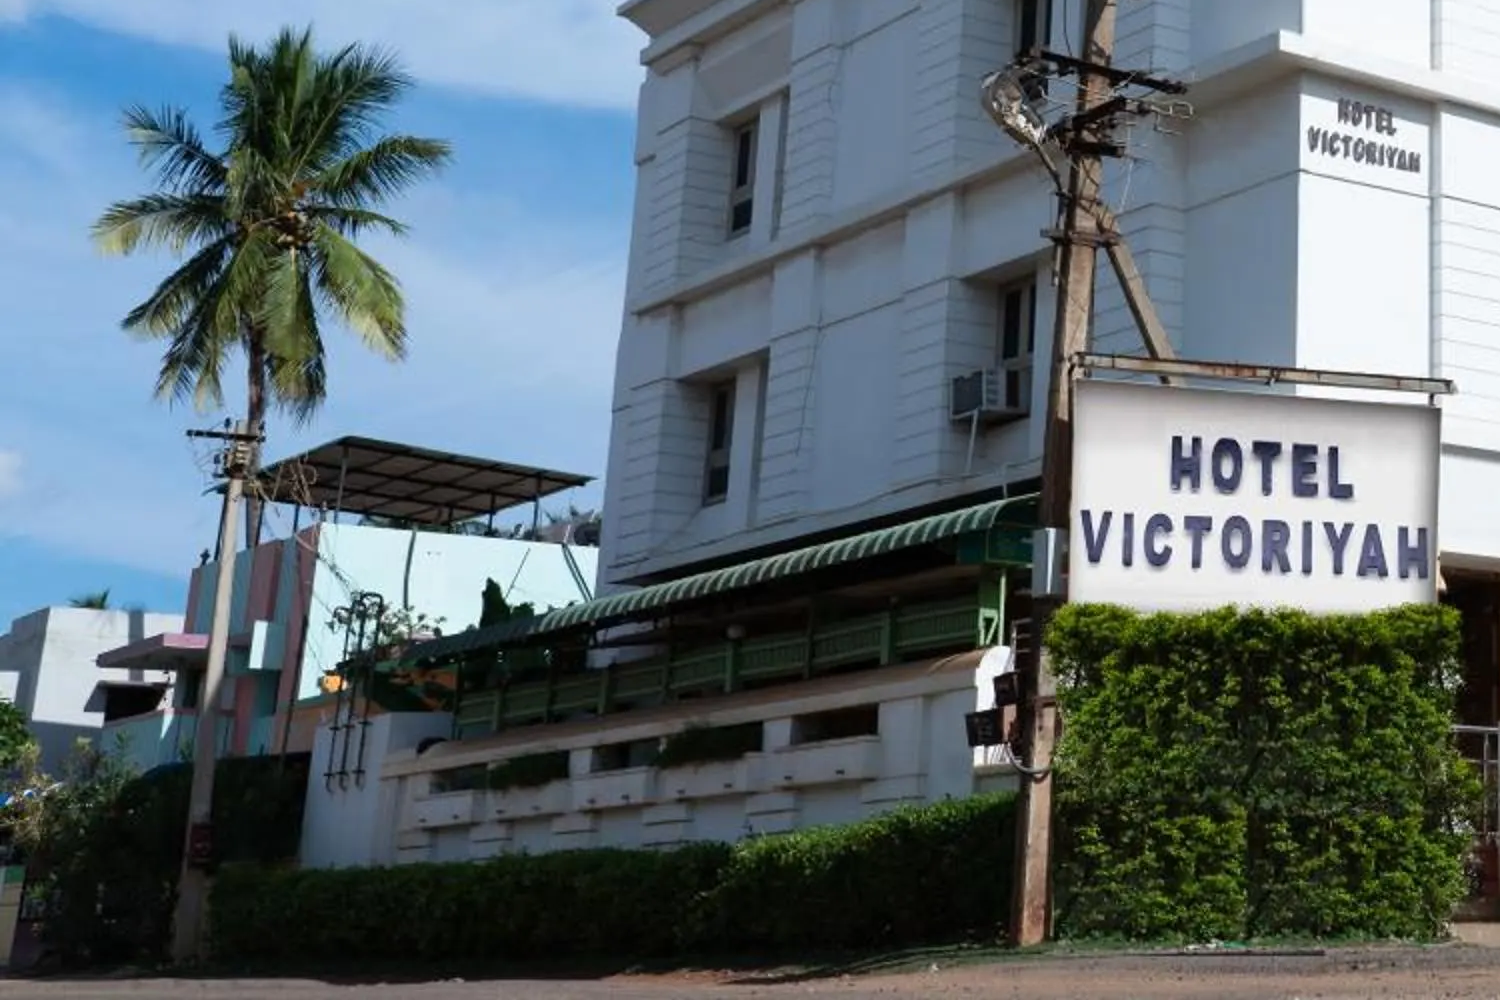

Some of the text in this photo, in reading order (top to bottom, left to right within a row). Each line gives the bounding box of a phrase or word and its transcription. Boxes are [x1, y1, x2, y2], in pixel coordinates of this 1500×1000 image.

[1338, 98, 1397, 136] HOTEL
[1307, 125, 1421, 173] VICTORIYAH
[1169, 435, 1354, 499] HOTEL
[1080, 509, 1429, 579] VICTORIYAH
